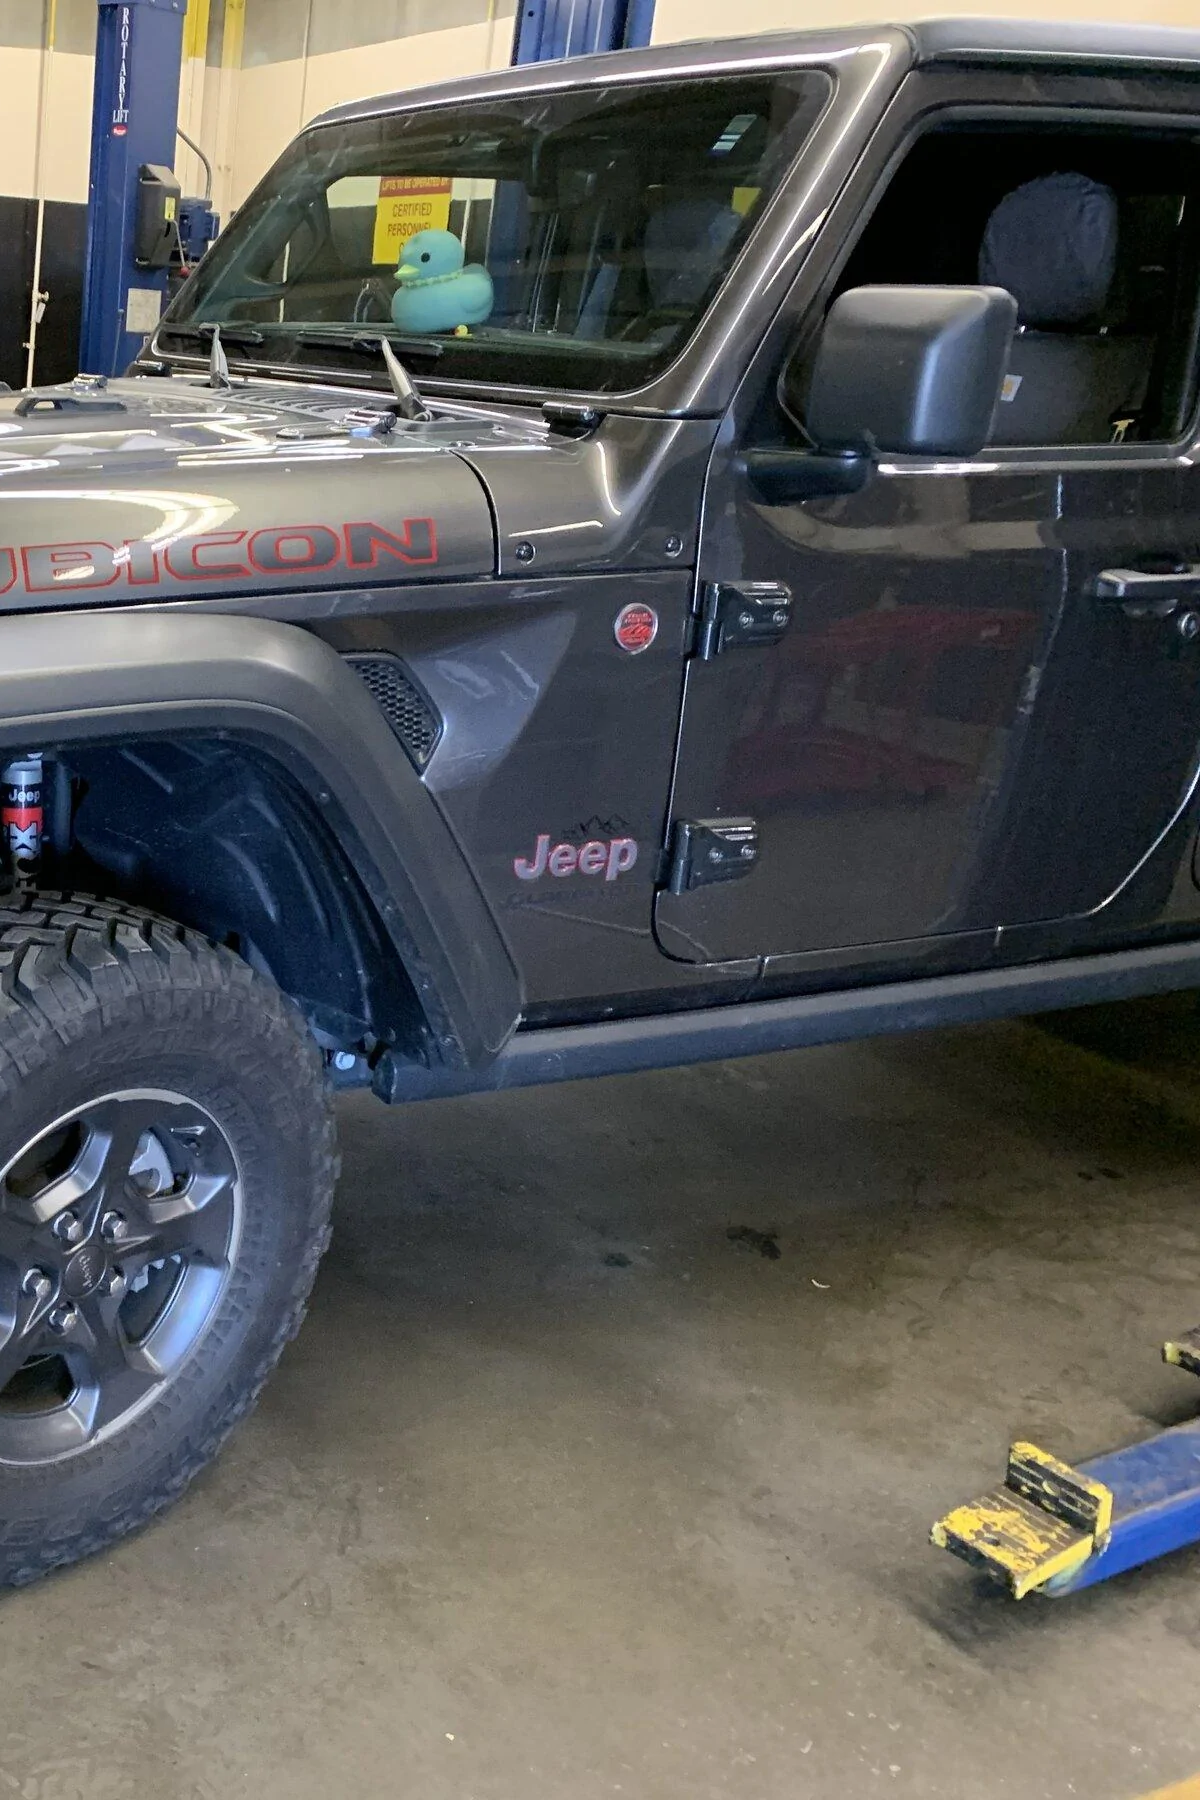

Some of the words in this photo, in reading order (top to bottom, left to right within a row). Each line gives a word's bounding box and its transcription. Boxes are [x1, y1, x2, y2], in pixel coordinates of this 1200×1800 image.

[118, 7, 130, 110] ROTARY
[113, 109, 129, 123] LIFT
[397, 179, 404, 189] TO
[404, 179, 411, 189] BE
[412, 177, 439, 189] OPERATED
[392, 202, 432, 218] CERTIFIED
[9, 788, 40, 803] Jeep
[513, 834, 638, 881] Jeep
